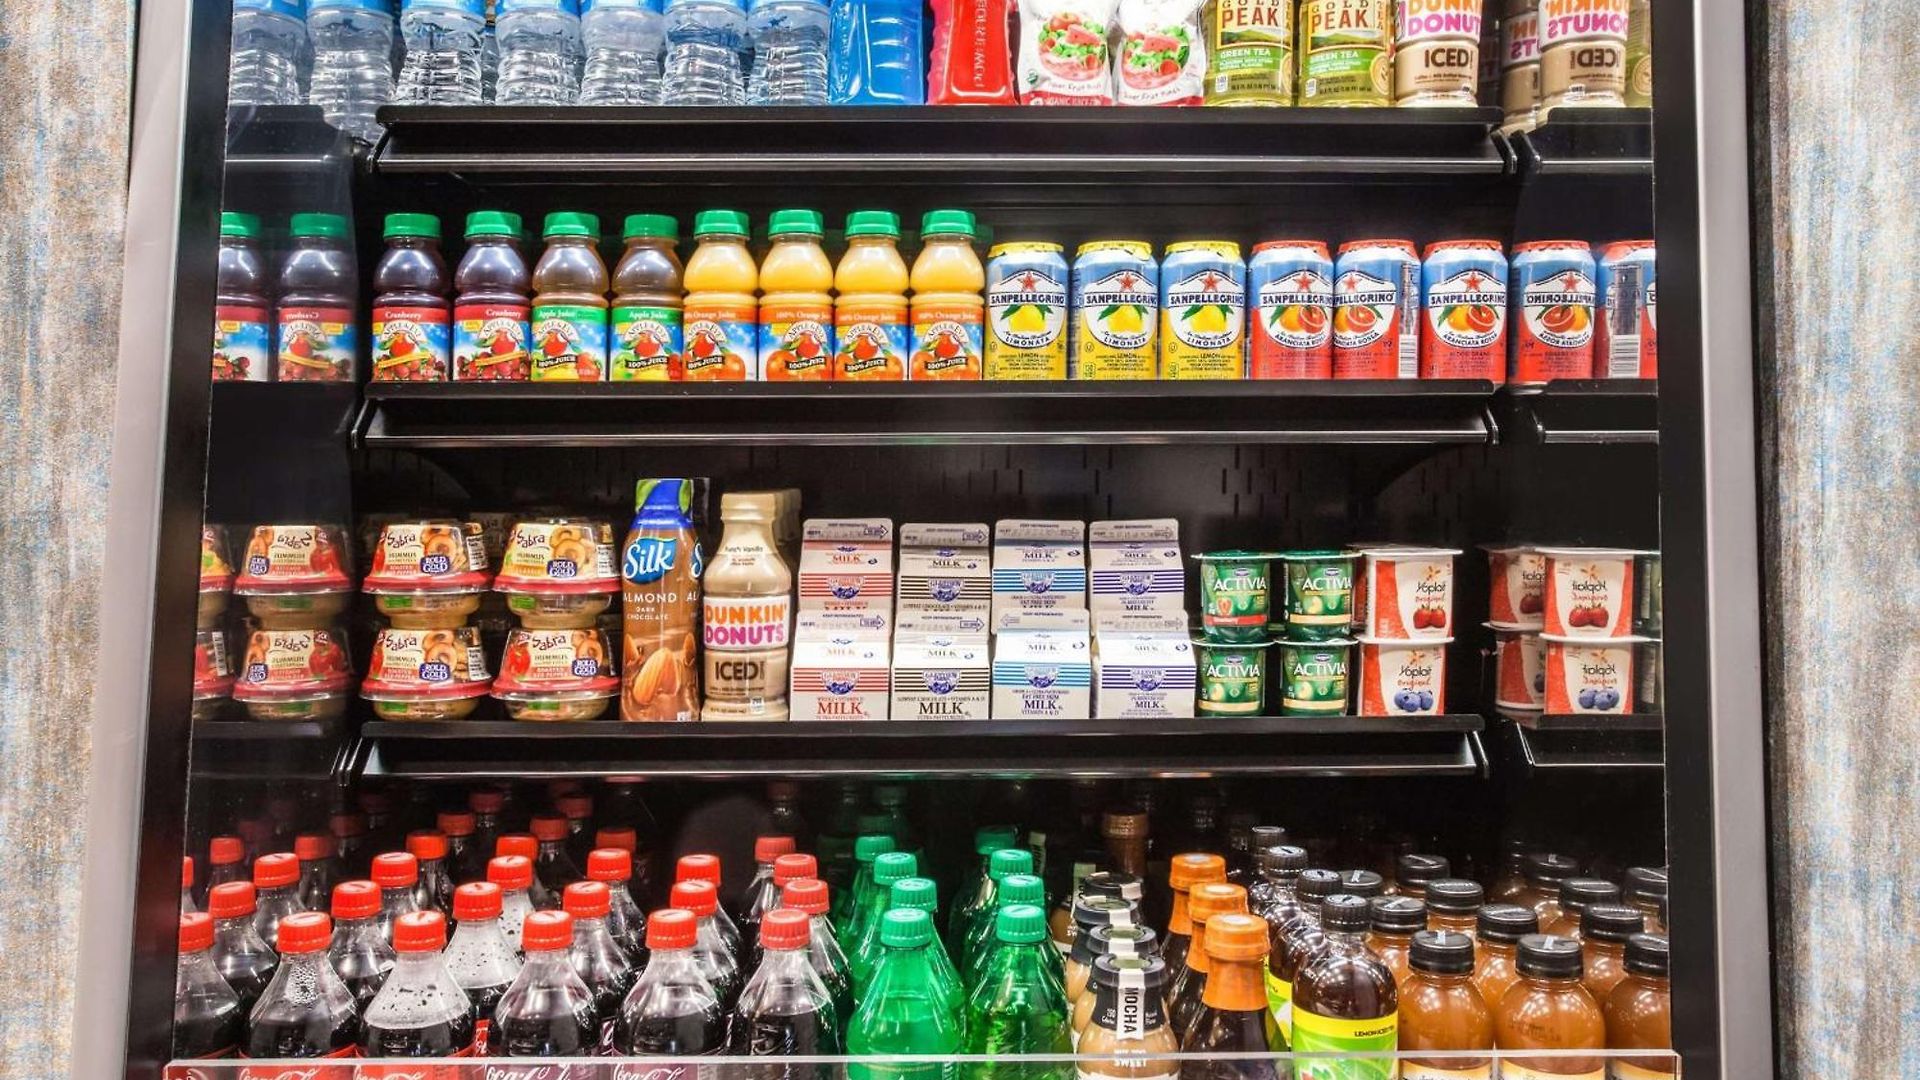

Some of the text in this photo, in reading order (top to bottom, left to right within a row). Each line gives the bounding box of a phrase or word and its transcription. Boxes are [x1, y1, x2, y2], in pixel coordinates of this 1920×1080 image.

[1311, 0, 1369, 13] GOLD
[1222, 7, 1278, 29] PEAK
[1311, 10, 1368, 33] PEAK
[1220, 50, 1250, 59] GREEN
[1425, 48, 1469, 68] ICED
[991, 294, 1065, 304] SANPELLEGRINO
[1170, 294, 1245, 304] SANPELLEGRINO
[385, 311, 421, 321] Cranberry
[485, 308, 521, 319] Cranberry
[538, 310, 557, 319] Apple
[629, 311, 649, 320] Apple
[693, 311, 717, 320] Orange
[796, 311, 821, 320] Orange
[853, 313, 879, 321] Orange
[935, 312, 961, 320] Orange
[1005, 336, 1050, 347] LIMONATA
[1104, 336, 1147, 347] LIMONATA
[1187, 336, 1231, 347] LIMONATA
[1443, 334, 1480, 346] ARANCIATA
[556, 355, 576, 364] JUICE
[628, 356, 668, 369] 100% JUICE
[703, 356, 723, 365] JUICE
[867, 359, 886, 367] JUICE
[386, 532, 416, 549] Sabra
[516, 529, 545, 548] Sabra
[623, 541, 674, 579] Silk
[422, 563, 449, 573] GOLD
[549, 568, 577, 577] GOLD
[1213, 577, 1267, 591] ACTIVIA
[1302, 577, 1352, 591] ACTIVIA
[1416, 581, 1446, 597] Yoplait
[623, 592, 677, 603] ALMOND
[705, 604, 787, 625] DUNKIN'
[705, 624, 784, 645] DONUTS
[385, 636, 417, 651] Sabra
[531, 635, 567, 651] Sabra
[928, 649, 958, 657] MILK
[422, 671, 449, 680] GOLD
[715, 661, 759, 681] ICED
[1207, 663, 1261, 677] ACTIVIA
[1294, 663, 1346, 677] ACTIVIA
[1400, 665, 1432, 680] Yoplait
[817, 702, 863, 715] MILK
[919, 702, 963, 715] MILK
[1024, 700, 1057, 710] MILK
[1135, 701, 1159, 709] MILK
[1124, 987, 1139, 1033] MOCHA
